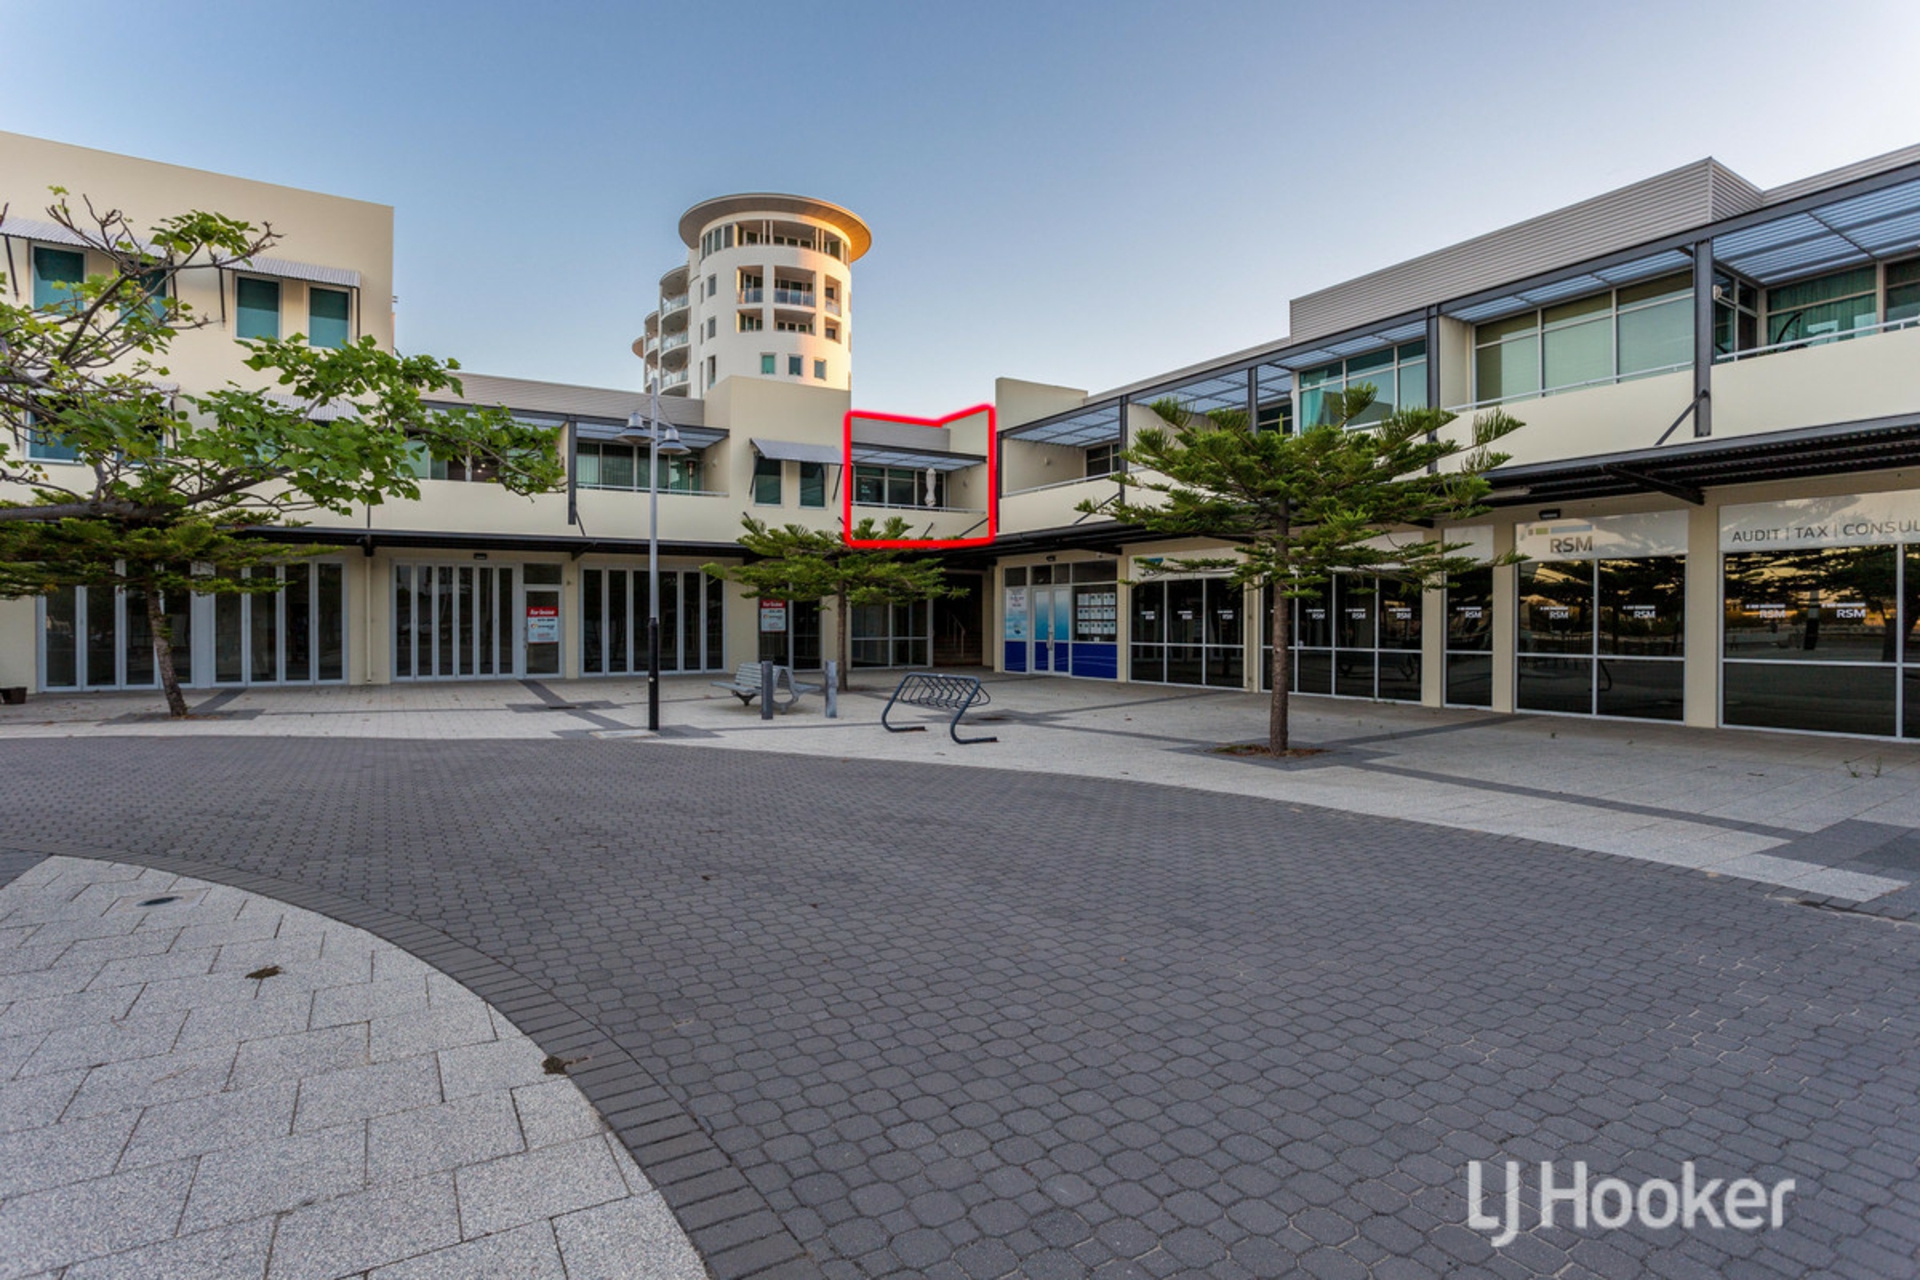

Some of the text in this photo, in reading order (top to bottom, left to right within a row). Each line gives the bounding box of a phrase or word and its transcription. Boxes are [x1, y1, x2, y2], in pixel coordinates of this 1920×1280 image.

[1732, 529, 1780, 543] AUDIT
[1795, 525, 1829, 539] TAX
[1549, 535, 1593, 554] RSM
[1465, 611, 1482, 619] RSM
[1549, 611, 1569, 620] RSM
[1634, 610, 1656, 619] RSM
[1760, 609, 1786, 619] RSM
[1837, 608, 1866, 618] RSM
